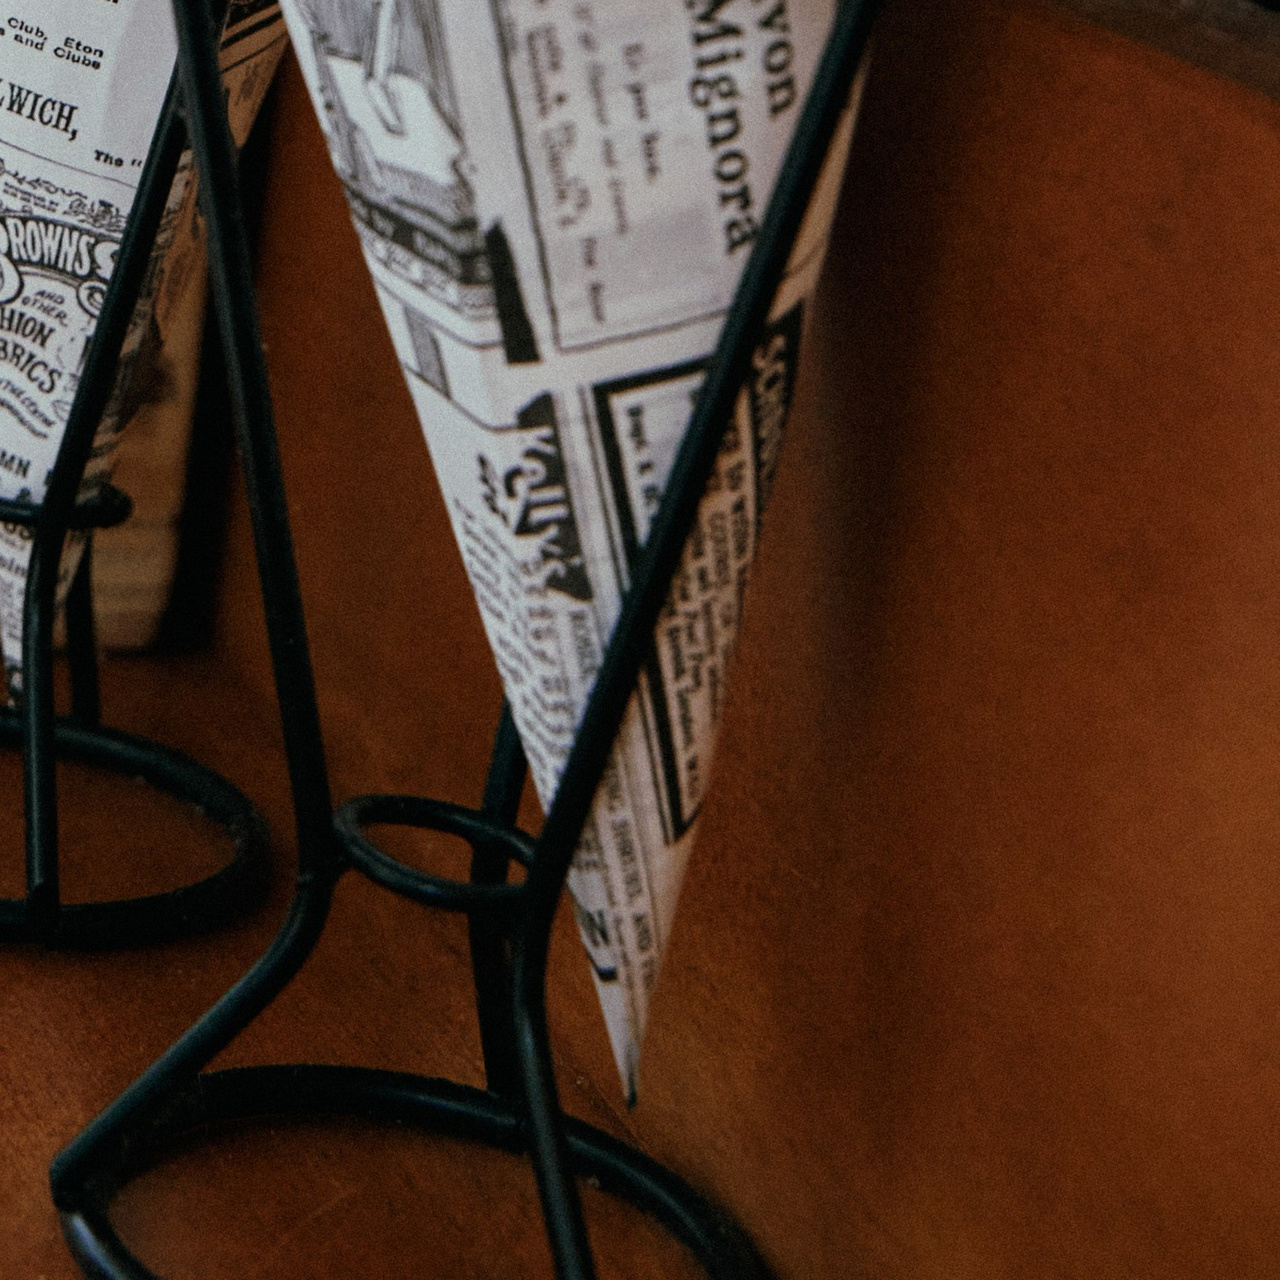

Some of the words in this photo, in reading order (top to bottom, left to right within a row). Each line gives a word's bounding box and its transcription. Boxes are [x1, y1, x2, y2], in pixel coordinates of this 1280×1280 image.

[7, 17, 48, 40] Club,
[63, 37, 105, 58] Eton
[14, 33, 45, 51] and
[53, 47, 101, 70] Clubs
[94, 149, 124, 167] The
[21, 296, 68, 327] OTHER
[36, 290, 65, 304] AND
